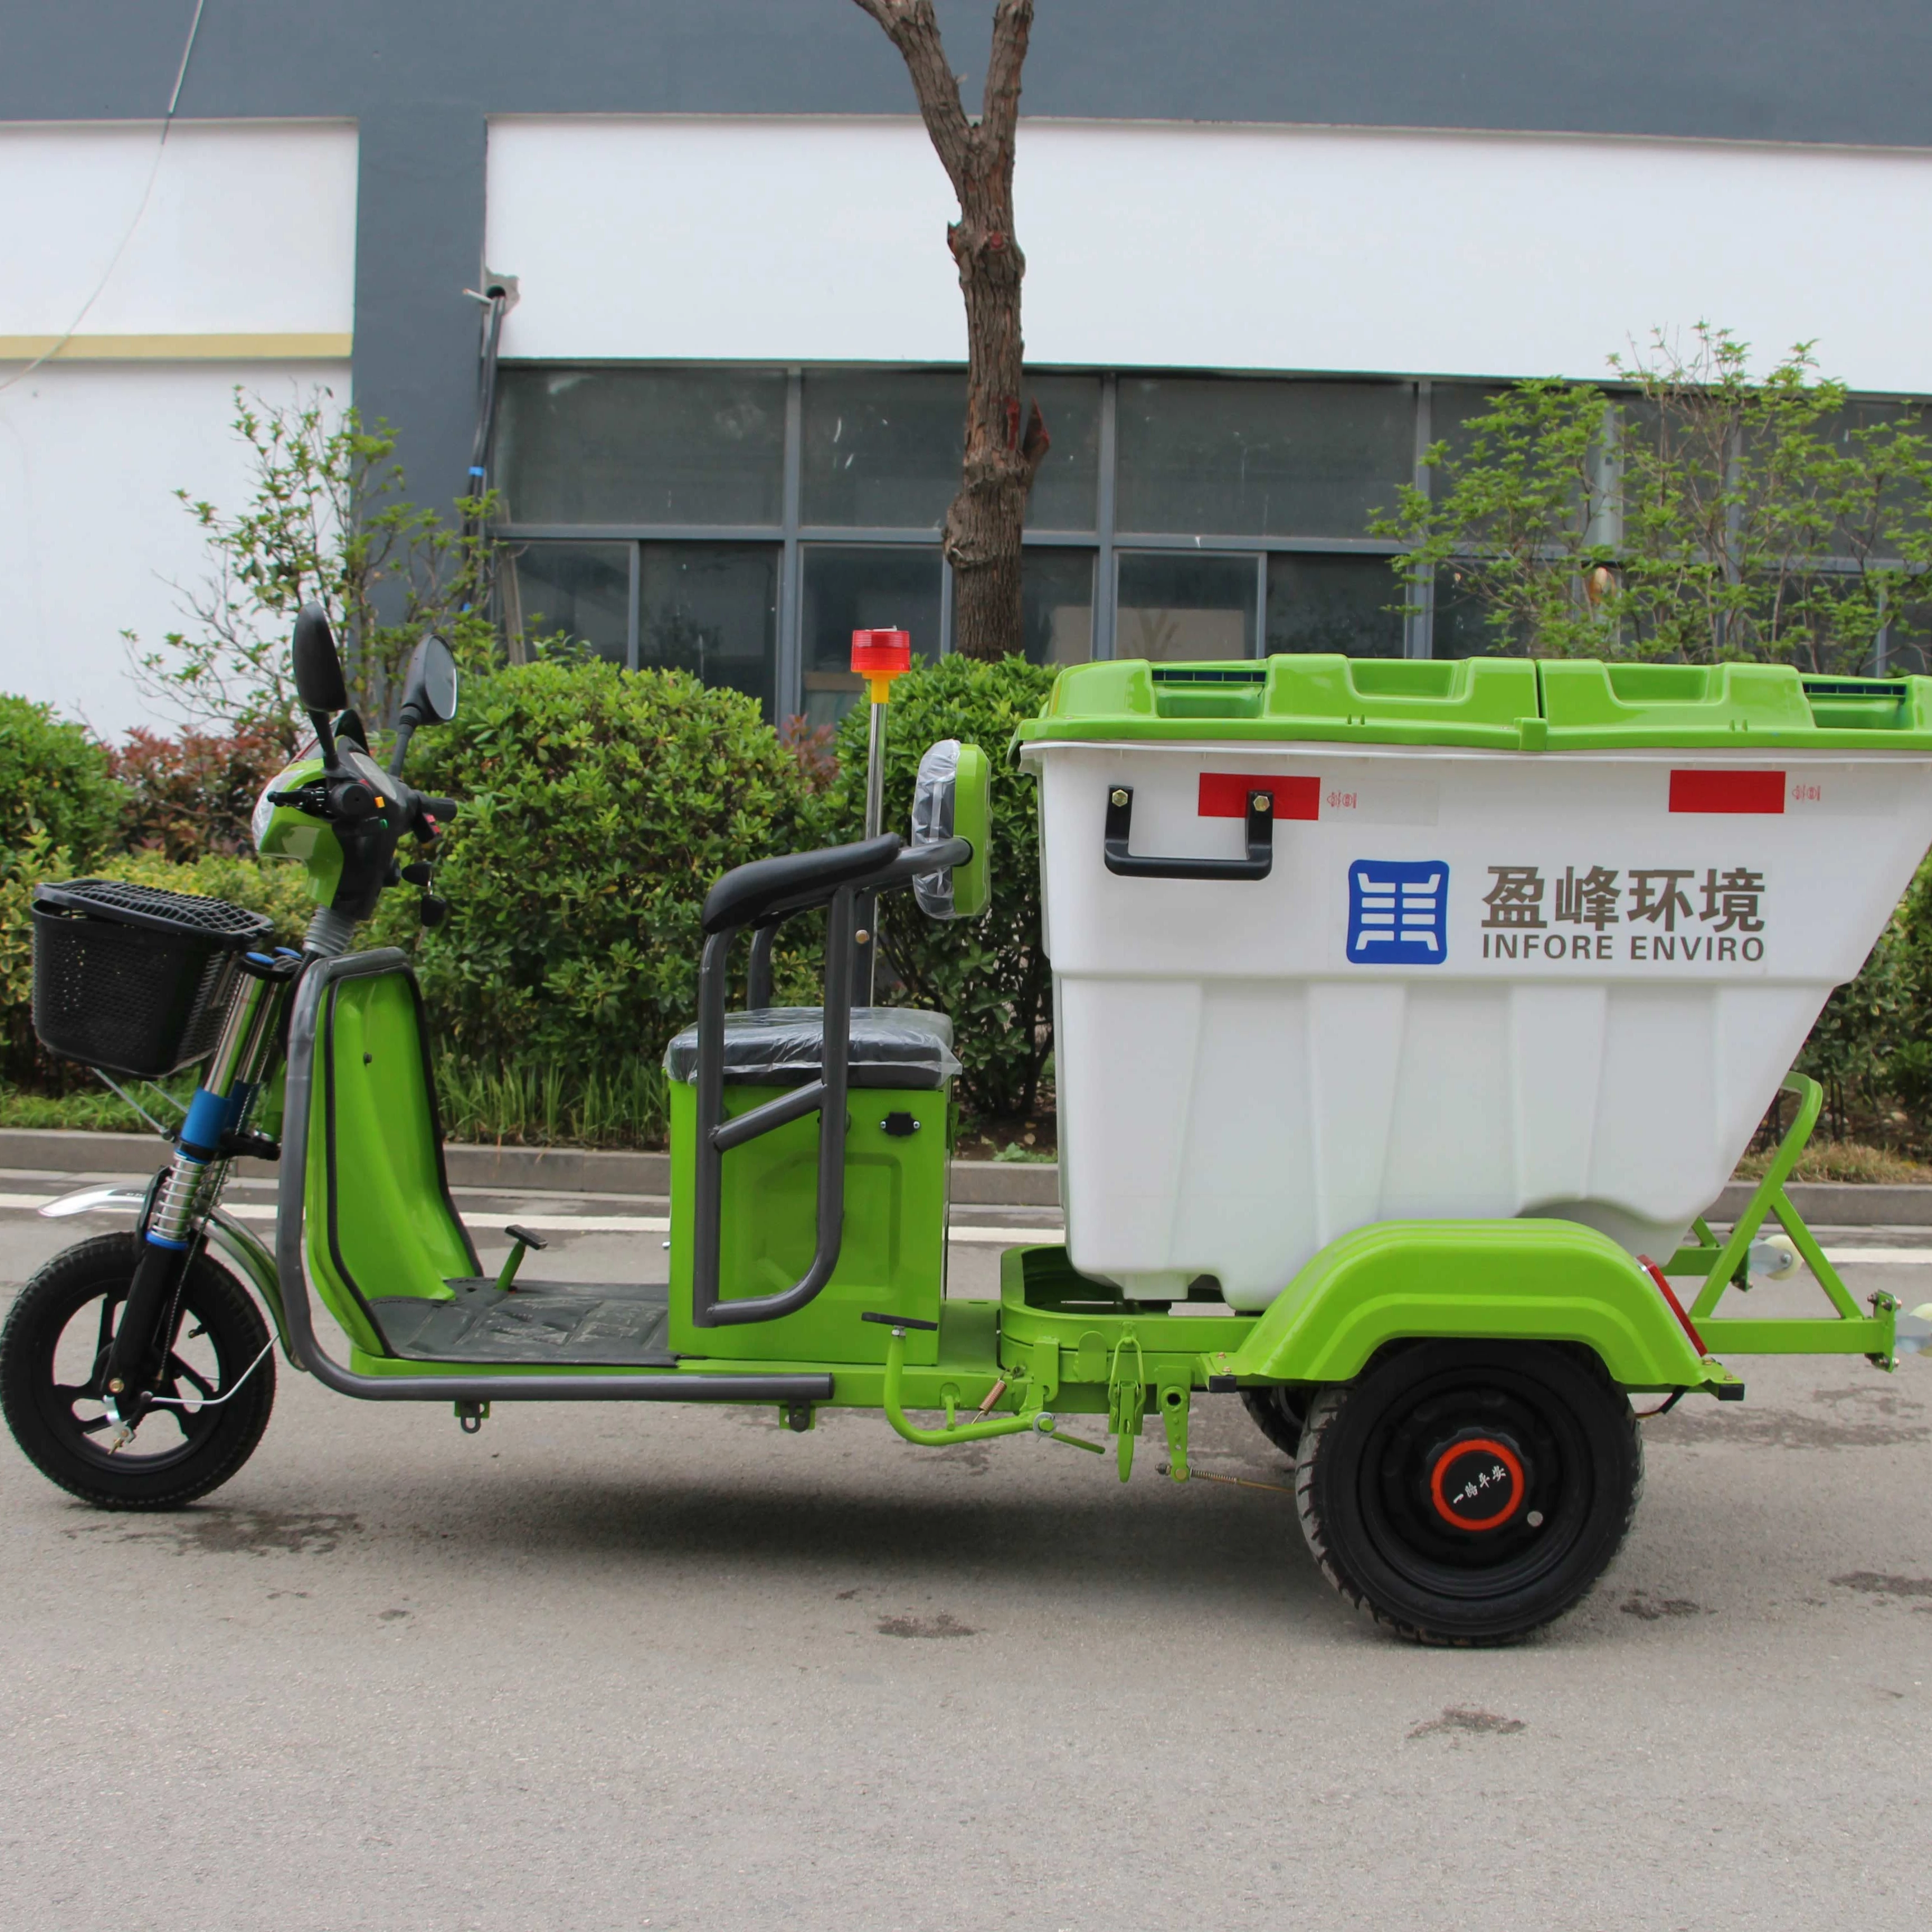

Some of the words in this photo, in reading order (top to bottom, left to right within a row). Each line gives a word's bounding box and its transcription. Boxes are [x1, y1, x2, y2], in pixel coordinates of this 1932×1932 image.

[1481, 865, 1765, 933] 盈峰环境
[1483, 934, 1613, 960] INFORE
[1630, 935, 1764, 962] ENVIRO
[1453, 1465, 1506, 1504] 一路平安
